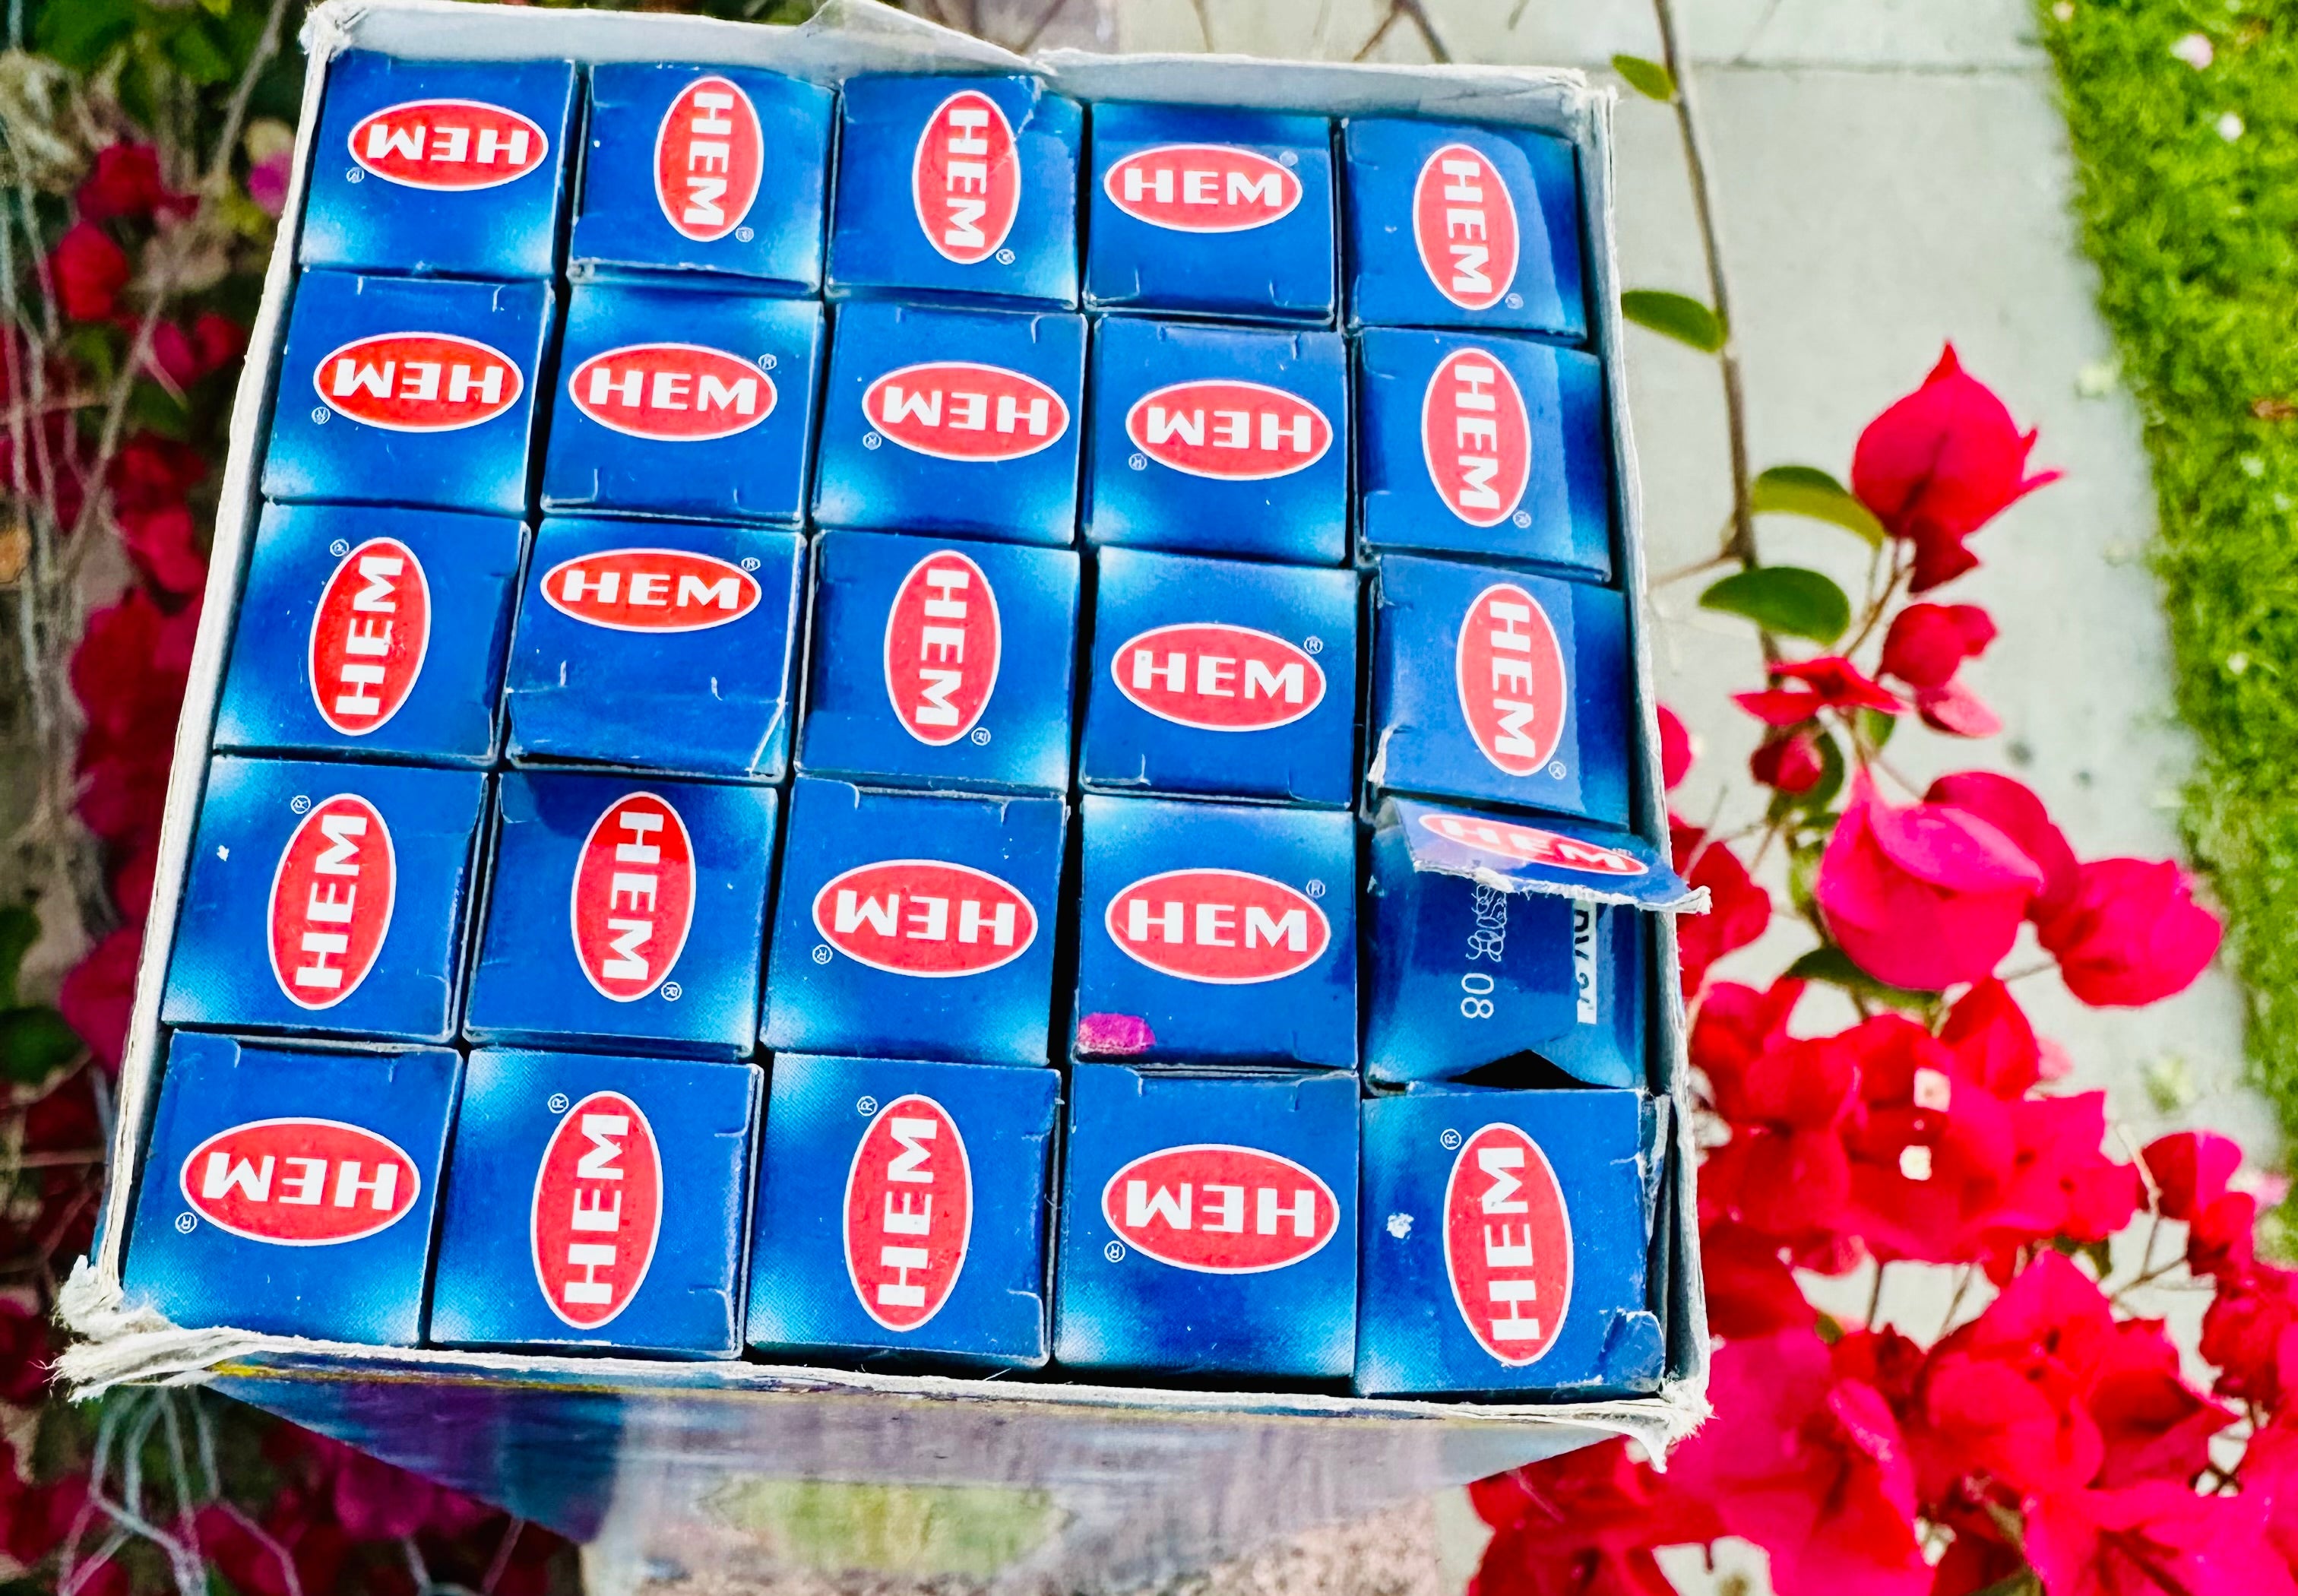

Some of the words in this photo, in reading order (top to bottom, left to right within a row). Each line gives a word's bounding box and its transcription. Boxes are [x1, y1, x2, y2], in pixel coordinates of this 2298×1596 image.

[367, 124, 529, 164] HEM
[683, 90, 733, 226] HEM
[945, 109, 989, 248] HEM
[1124, 163, 1277, 207] HEM
[1442, 160, 1492, 294] HEM
[333, 359, 503, 404] HEM
[589, 368, 757, 415] HEM
[882, 385, 1049, 435] HEM
[1147, 404, 1312, 452] HEM
[1454, 363, 1501, 511] HEM
[562, 570, 740, 609] HEM
[335, 556, 404, 715] HEM
[916, 568, 970, 727] HEM
[1133, 649, 1304, 704] HEM
[1489, 600, 1535, 757] HEM
[1441, 819, 1627, 871] HEM
[296, 815, 367, 988] HEM
[603, 812, 663, 980] HEM
[834, 889, 1015, 946] HEM
[1118, 899, 1307, 952] HEM
[1461, 972, 1494, 1019] 08
[202, 1152, 398, 1210] HEM
[565, 1114, 629, 1304] HEM
[1126, 1180, 1315, 1237] HEM
[878, 1117, 937, 1307] HEM
[1477, 1148, 1541, 1341] HEM
